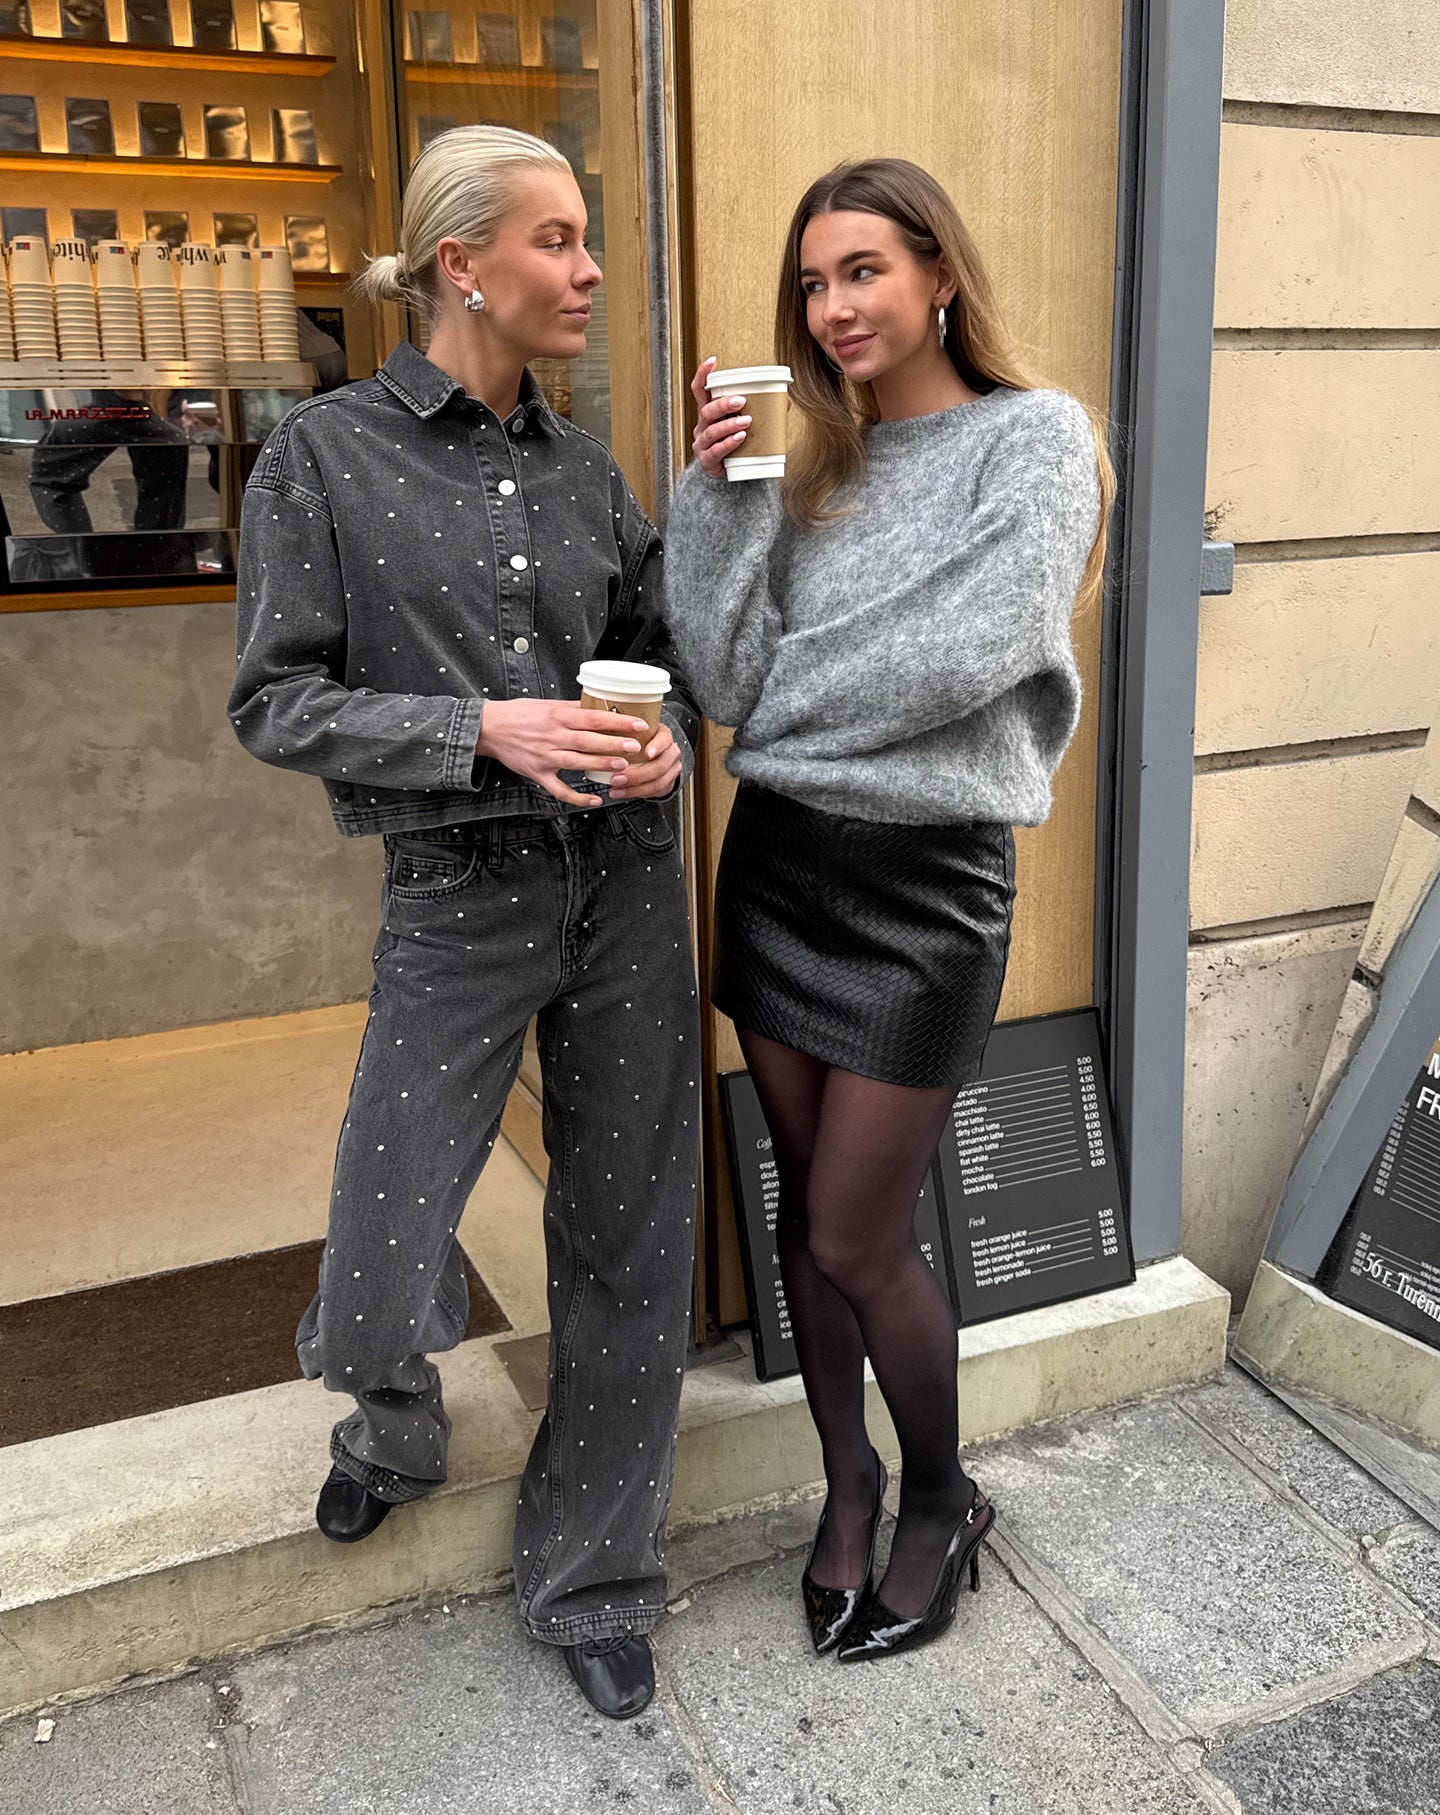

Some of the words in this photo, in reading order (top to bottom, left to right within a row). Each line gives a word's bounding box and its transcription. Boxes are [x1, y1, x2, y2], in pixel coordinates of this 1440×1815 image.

[55, 242, 86, 262] hite
[1079, 1074, 1095, 1083] 4.50
[953, 1106, 988, 1118] macchiato
[1081, 1083, 1096, 1092] 4.00
[954, 1119, 969, 1128] chai
[969, 1116, 984, 1125] latte
[1082, 1093, 1097, 1102] 6.00
[1416, 1086, 1440, 1121] FR
[956, 1129, 971, 1138] dirty
[971, 1126, 985, 1134] chai
[985, 1123, 1000, 1131] latte
[1083, 1102, 1098, 1111] 6.50
[957, 1134, 989, 1147] cinnamon
[989, 1132, 1004, 1140] latte
[1084, 1111, 1099, 1121] 6.00
[756, 1137, 773, 1150] Coff
[958, 1145, 984, 1157] spanish
[984, 1142, 1000, 1151] latte
[1086, 1120, 1101, 1130] 6.00
[759, 1160, 776, 1170] espr
[961, 1165, 984, 1176] mocha
[971, 1154, 989, 1163] white
[762, 1180, 780, 1191] allon
[962, 1173, 995, 1185] chocolate
[963, 1184, 987, 1195] london
[986, 1182, 998, 1191] fog
[1091, 1158, 1106, 1167] 6.00
[763, 1191, 780, 1201] ame
[968, 1216, 986, 1228] Fresh
[970, 1237, 988, 1248] fresh
[988, 1234, 1012, 1244] orange
[1011, 1229, 1028, 1240] juice
[1098, 1208, 1113, 1218] 5.00
[972, 1248, 990, 1257] fresh
[989, 1244, 1010, 1253] lemon
[1010, 1240, 1027, 1250] juice
[1099, 1218, 1114, 1228] 5.00
[973, 1257, 991, 1267] fresh
[990, 1248, 1036, 1264] orange-lemon
[1035, 1243, 1052, 1254] juice
[1100, 1227, 1116, 1237] 5.00
[975, 1267, 992, 1277] fresh
[992, 1260, 1025, 1273] lemonade
[1102, 1237, 1117, 1246] 5.00
[976, 1276, 994, 1287] fresh
[993, 1272, 1015, 1284] ginger
[1014, 1268, 1032, 1278] soda
[1103, 1246, 1118, 1256] 5.00
[1362, 1252, 1384, 1278] 56
[1397, 1271, 1440, 1323] Turenn
[780, 1320, 792, 1329] ice
[781, 1330, 793, 1339] ice
